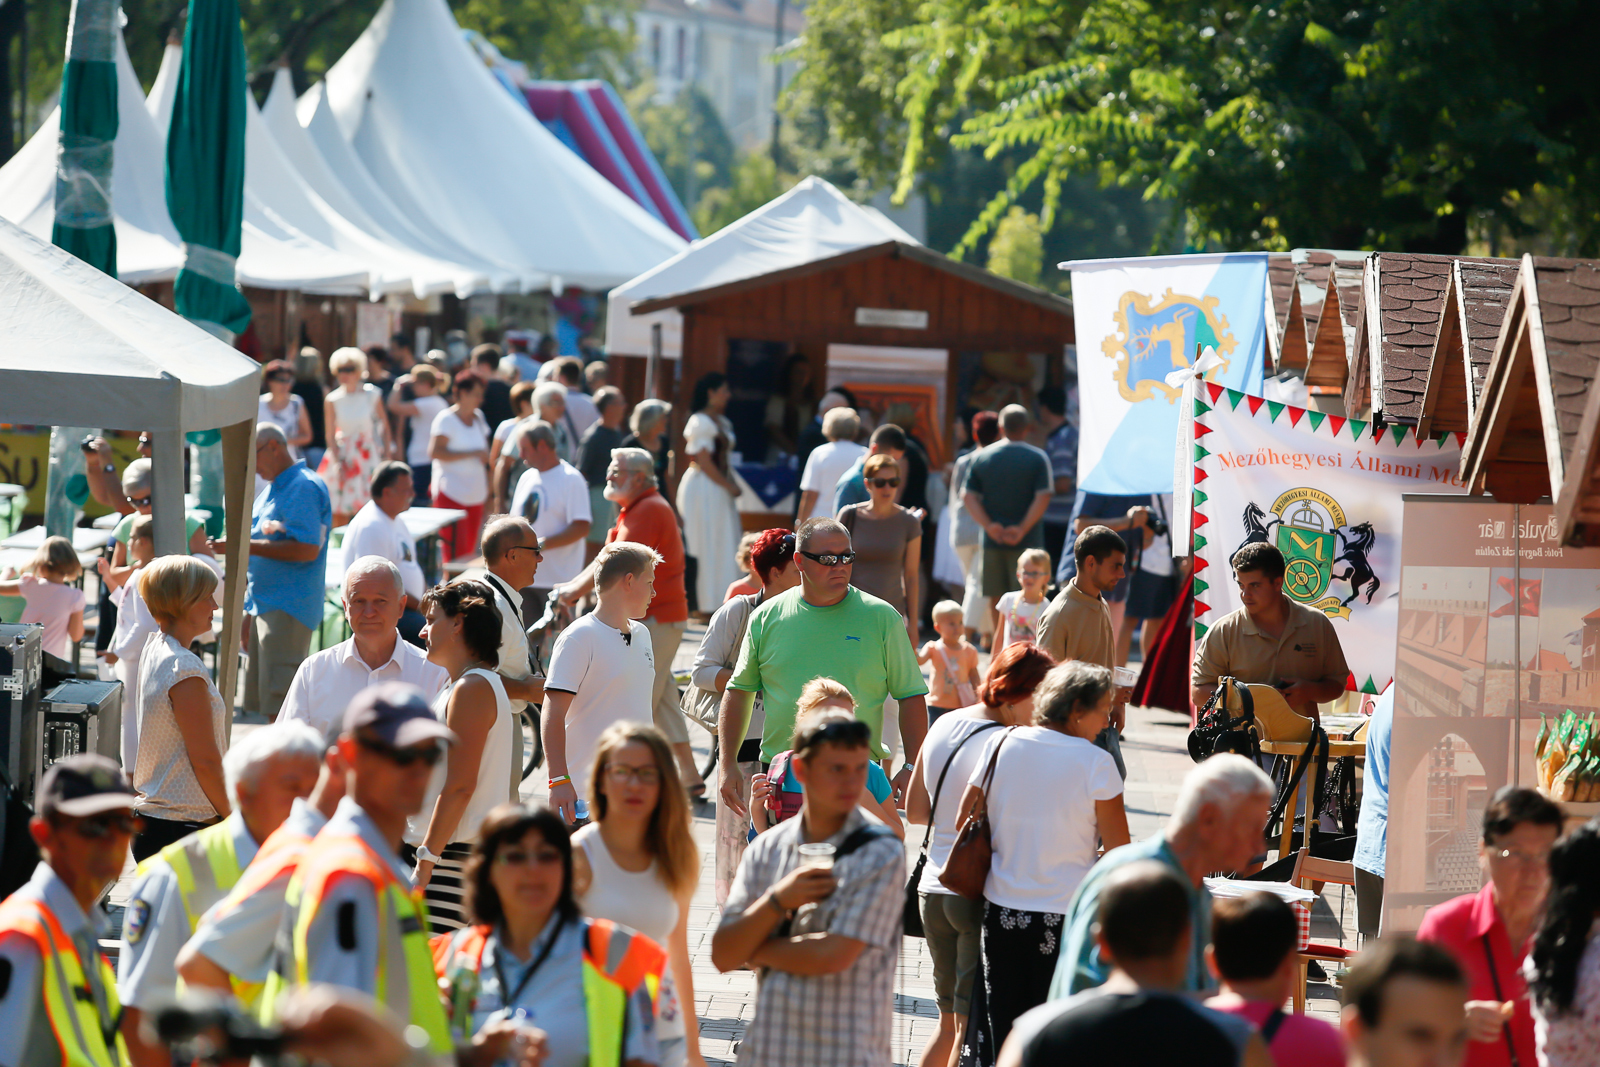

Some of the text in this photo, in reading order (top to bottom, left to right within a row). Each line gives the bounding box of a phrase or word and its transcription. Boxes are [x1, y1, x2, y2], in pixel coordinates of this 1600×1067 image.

[1217, 448, 1342, 471] Mezőhegyesi
[1350, 450, 1421, 479] Állami
[1310, 489, 1332, 506] ÁLLAMI
